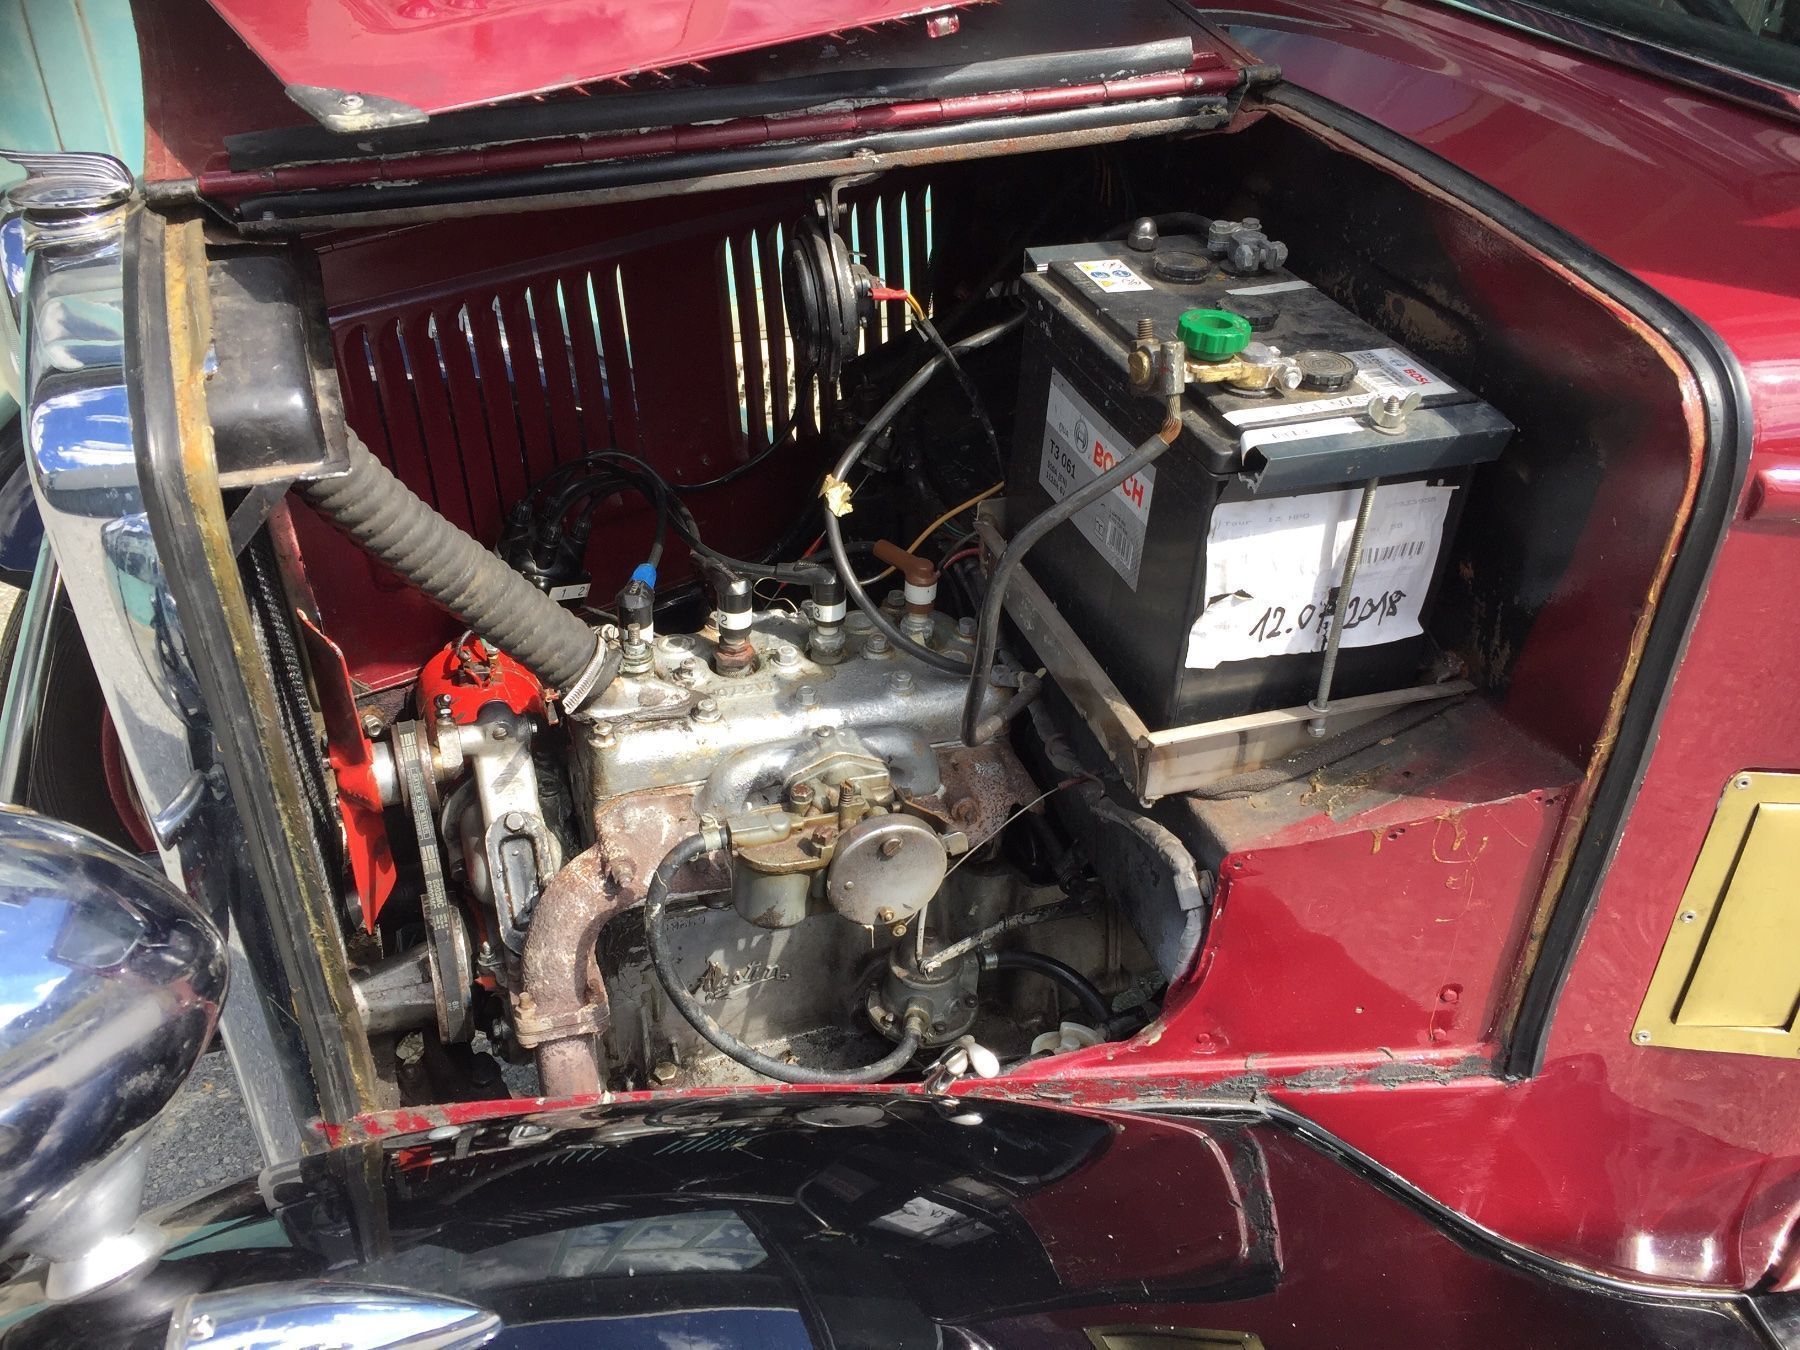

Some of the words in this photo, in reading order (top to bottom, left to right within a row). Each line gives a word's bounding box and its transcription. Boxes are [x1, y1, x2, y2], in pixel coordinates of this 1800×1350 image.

[1050, 439, 1060, 460] T3
[1061, 453, 1076, 480] 061
[1094, 441, 1144, 508] BOCH
[720, 615, 729, 626] 2
[813, 606, 821, 618] 3
